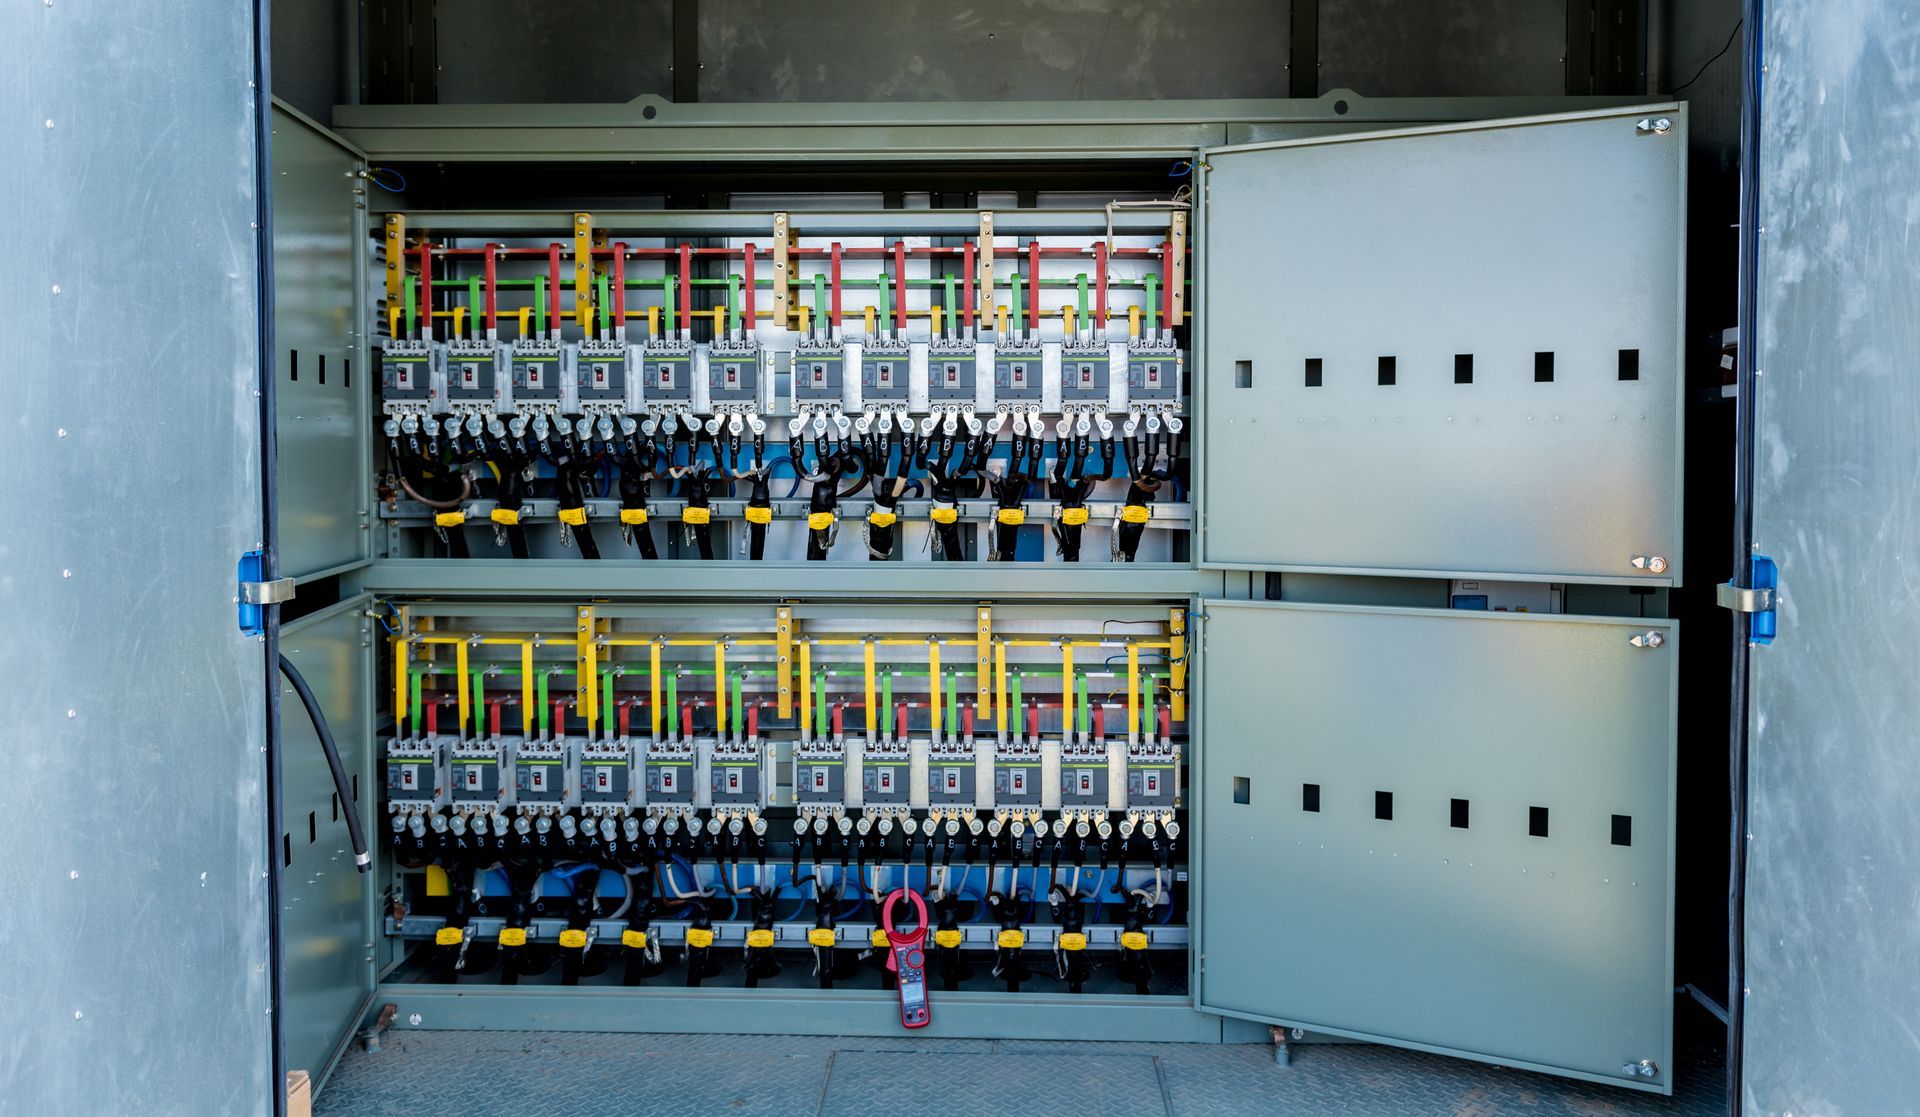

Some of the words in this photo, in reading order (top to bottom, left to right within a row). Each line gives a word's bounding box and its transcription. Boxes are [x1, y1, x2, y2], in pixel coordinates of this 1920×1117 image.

[391, 440, 398, 448] A
[410, 438, 418, 450] B
[452, 440, 458, 448] A
[475, 439, 484, 449] B
[500, 440, 506, 450] C
[516, 440, 524, 448] A
[564, 439, 570, 448] C
[626, 440, 632, 449] C
[646, 440, 655, 450] A
[713, 439, 718, 447] A
[732, 439, 738, 450] B
[791, 440, 802, 452] A
[820, 440, 828, 452] B
[841, 442, 848, 451] C
[864, 437, 872, 447] A
[880, 440, 887, 450] B
[904, 438, 910, 446] C
[920, 440, 928, 450] A
[944, 439, 951, 450] B
[968, 440, 975, 450] C
[984, 439, 992, 448] A
[1016, 442, 1023, 450] B
[1080, 440, 1086, 450] B
[430, 443, 436, 453] C
[541, 443, 547, 452] B
[582, 442, 588, 452] A
[606, 443, 614, 453] B
[1060, 442, 1067, 452] A
[1106, 444, 1112, 452] C
[394, 836, 401, 844] A
[417, 840, 423, 848] B
[458, 838, 466, 848] A
[478, 837, 484, 847] B
[498, 839, 504, 848] C
[522, 836, 530, 844] A
[540, 836, 547, 846] B
[591, 837, 599, 847] A
[649, 836, 656, 848] A
[666, 838, 672, 847] B
[714, 836, 718, 844] A
[733, 837, 738, 846] B
[758, 838, 764, 846] C
[927, 839, 933, 848] A
[948, 840, 954, 848] B
[992, 840, 998, 848] A
[1016, 840, 1022, 848] B
[1054, 840, 1061, 850] A
[1102, 842, 1107, 850] C
[1122, 841, 1128, 850] A
[1153, 840, 1159, 850] B
